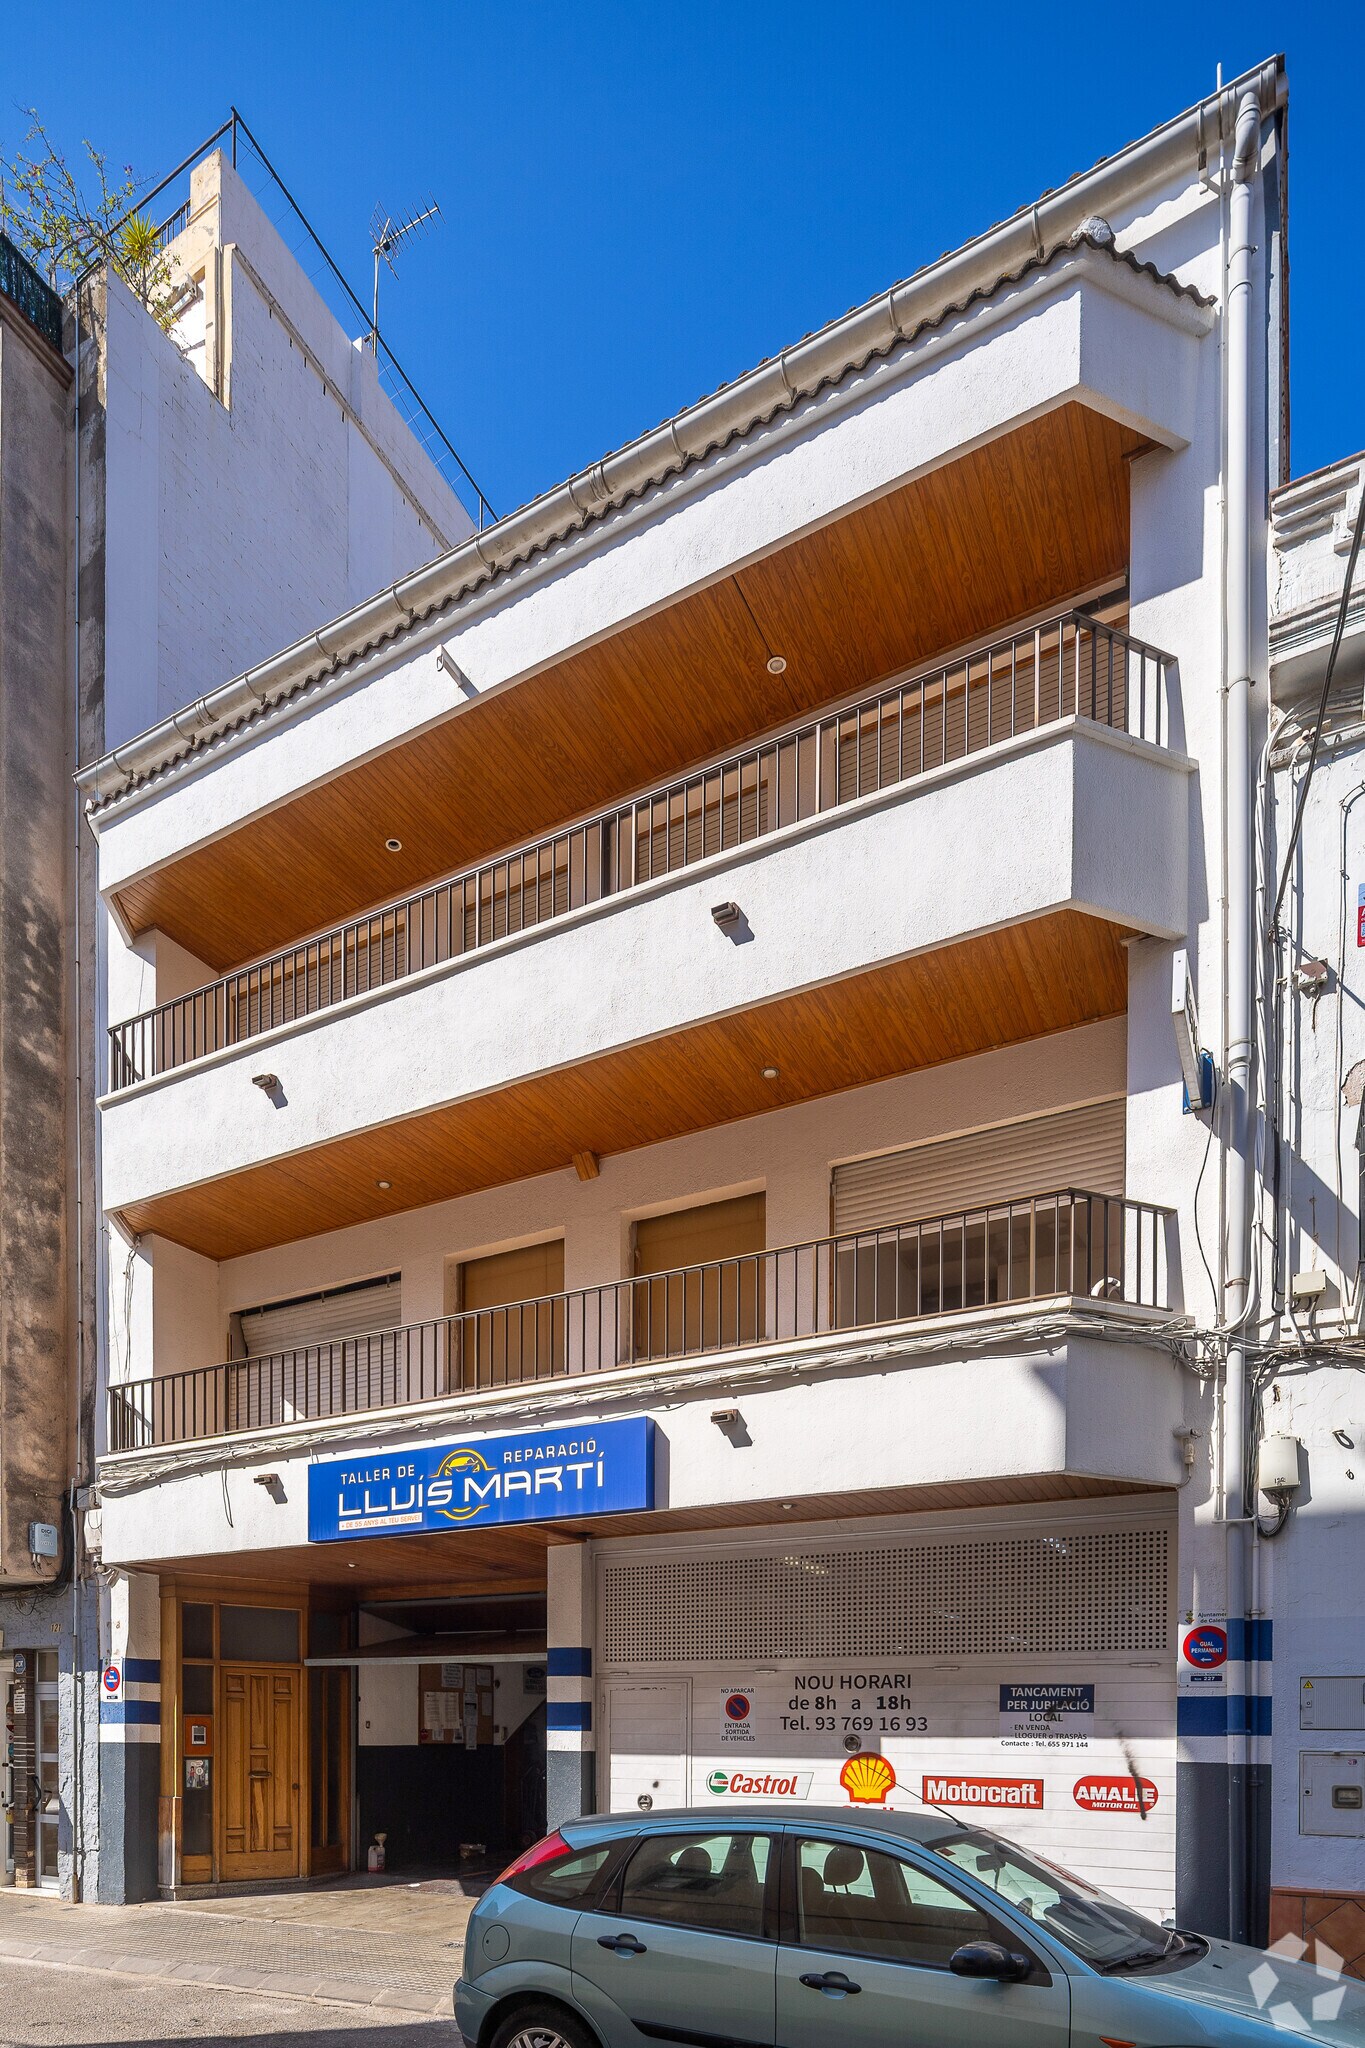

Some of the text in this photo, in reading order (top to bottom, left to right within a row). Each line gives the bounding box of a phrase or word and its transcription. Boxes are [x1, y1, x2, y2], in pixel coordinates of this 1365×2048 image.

[340, 1438, 597, 1485] TALLER DE REPARACIÓ
[338, 1452, 605, 1517] LLUÍS MARTÍ
[364, 1518, 379, 1526] ANYS
[794, 1674, 911, 1690] NOU HORARI
[1010, 1687, 1083, 1697] TANCAMENT
[788, 1695, 911, 1710] de 8h a 18h
[1007, 1700, 1027, 1710] PER
[780, 1716, 928, 1731] Tel. 93 769 16 93
[1029, 1713, 1063, 1722] LOCAL
[730, 1773, 798, 1795] Castrol
[927, 1780, 1037, 1804] Motorcraft
